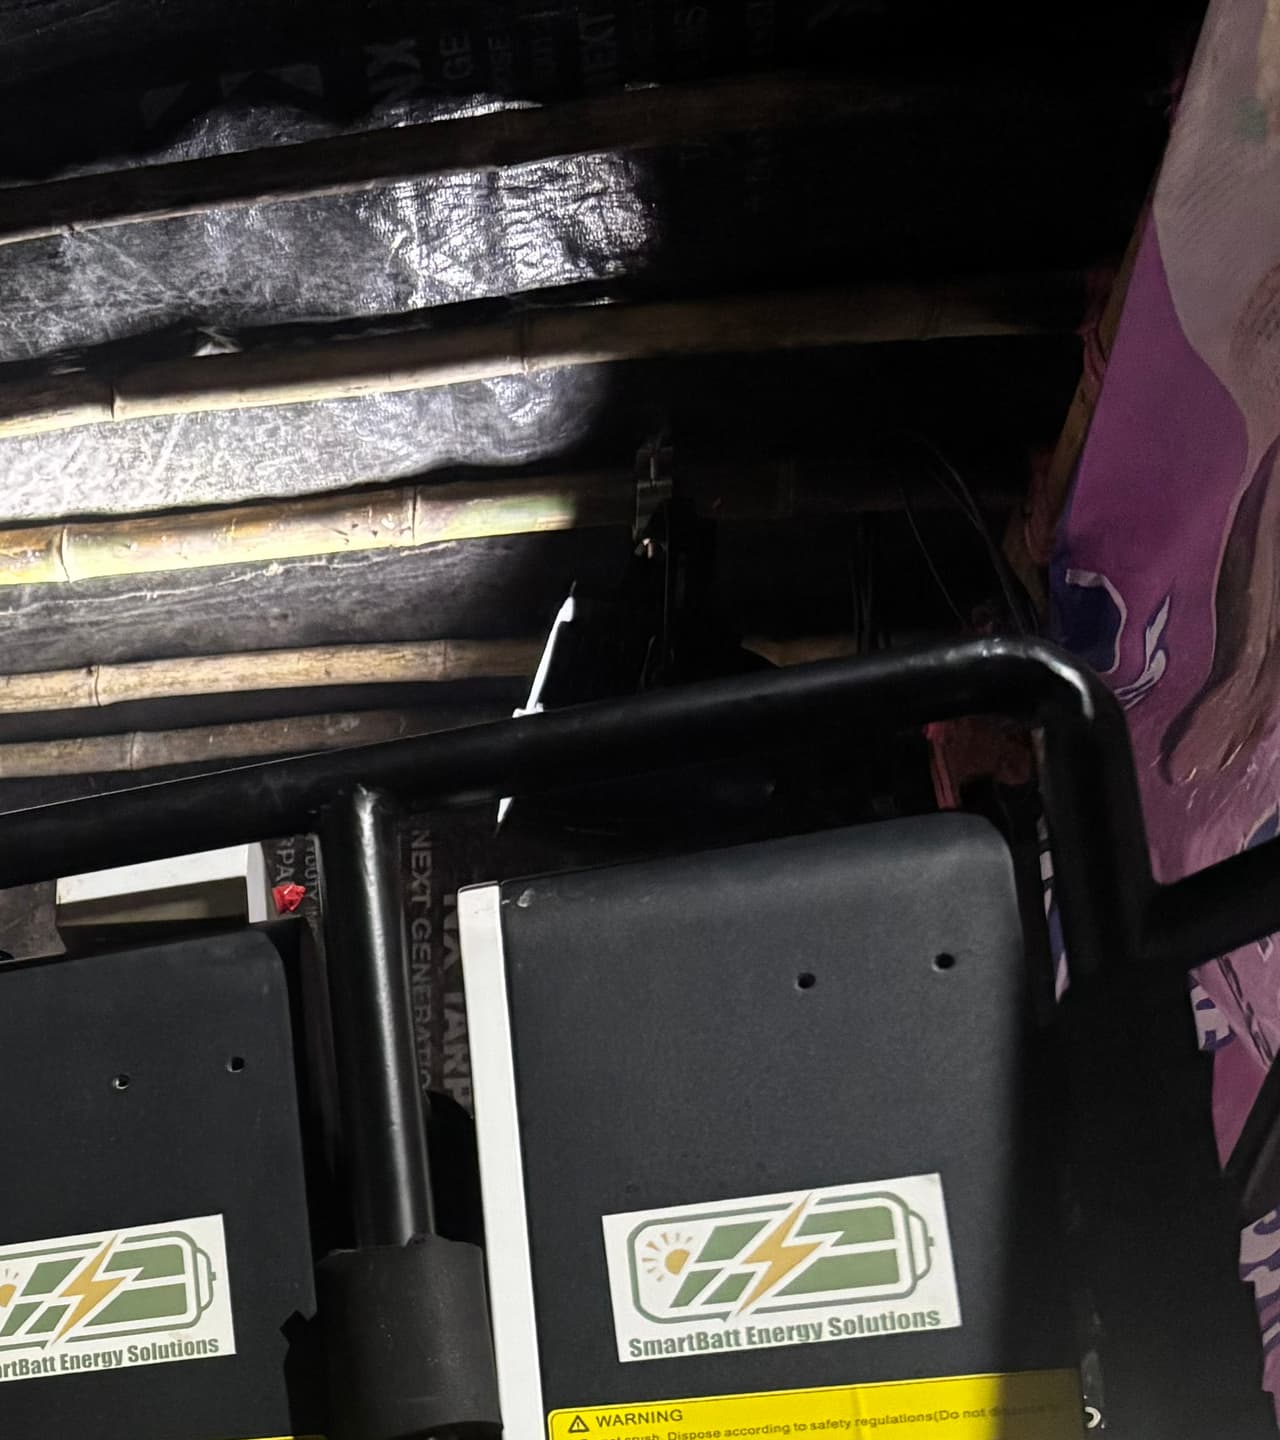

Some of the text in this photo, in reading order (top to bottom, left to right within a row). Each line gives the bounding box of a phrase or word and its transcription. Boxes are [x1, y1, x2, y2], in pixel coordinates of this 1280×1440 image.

[628, 1309, 942, 1358] SmartBatt Energy Solutions
[60, 1350, 124, 1370] Energy
[127, 1338, 220, 1362] Solutions
[594, 1408, 683, 1428] WARNING
